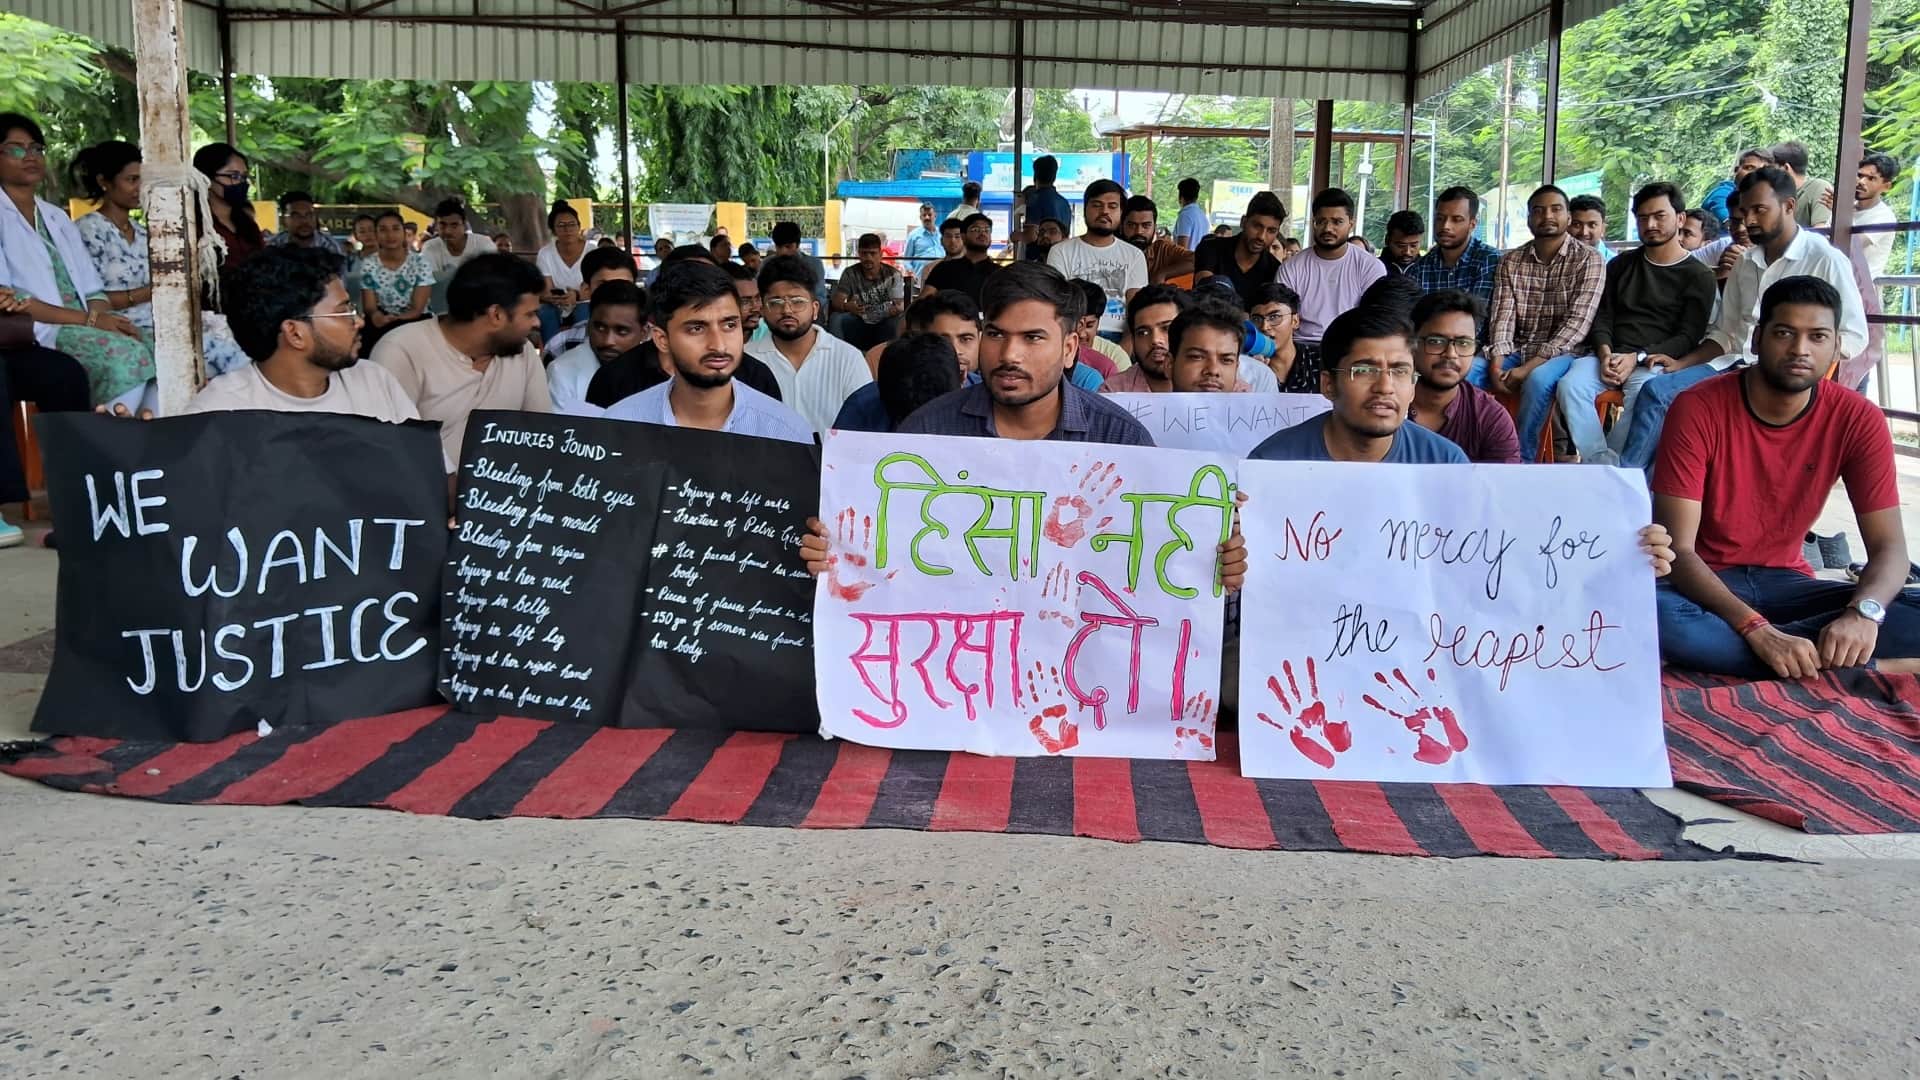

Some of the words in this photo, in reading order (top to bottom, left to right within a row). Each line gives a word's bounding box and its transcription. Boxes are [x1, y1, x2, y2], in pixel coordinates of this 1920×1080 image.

[1163, 406, 1209, 433] WE
[1227, 406, 1309, 432] WANT
[85, 470, 170, 541] WE
[537, 469, 563, 502] from
[569, 474, 600, 500] both
[603, 490, 635, 512] eyes
[737, 491, 762, 512] left
[528, 505, 554, 529] from
[562, 514, 601, 533] mouth
[724, 518, 736, 537] of
[744, 516, 776, 537] Pelvic
[873, 451, 1048, 582] हिंसा
[181, 518, 426, 598] WANT
[516, 534, 542, 559] from
[1274, 511, 1343, 562] No
[1539, 515, 1607, 589] for
[496, 564, 513, 581] at
[515, 567, 535, 585] her
[542, 576, 573, 594] neck
[491, 594, 508, 608] in
[512, 595, 551, 624] belly
[693, 593, 709, 612] of
[749, 600, 783, 619] found
[121, 591, 428, 696] JUSTICE
[488, 622, 501, 636] in
[508, 624, 535, 646] left
[650, 632, 668, 649] her
[693, 617, 704, 635] of
[707, 620, 747, 636] semen
[772, 632, 805, 650] found
[1325, 603, 1398, 662] the
[485, 651, 498, 665] at
[848, 611, 1026, 729] सुरक्षा
